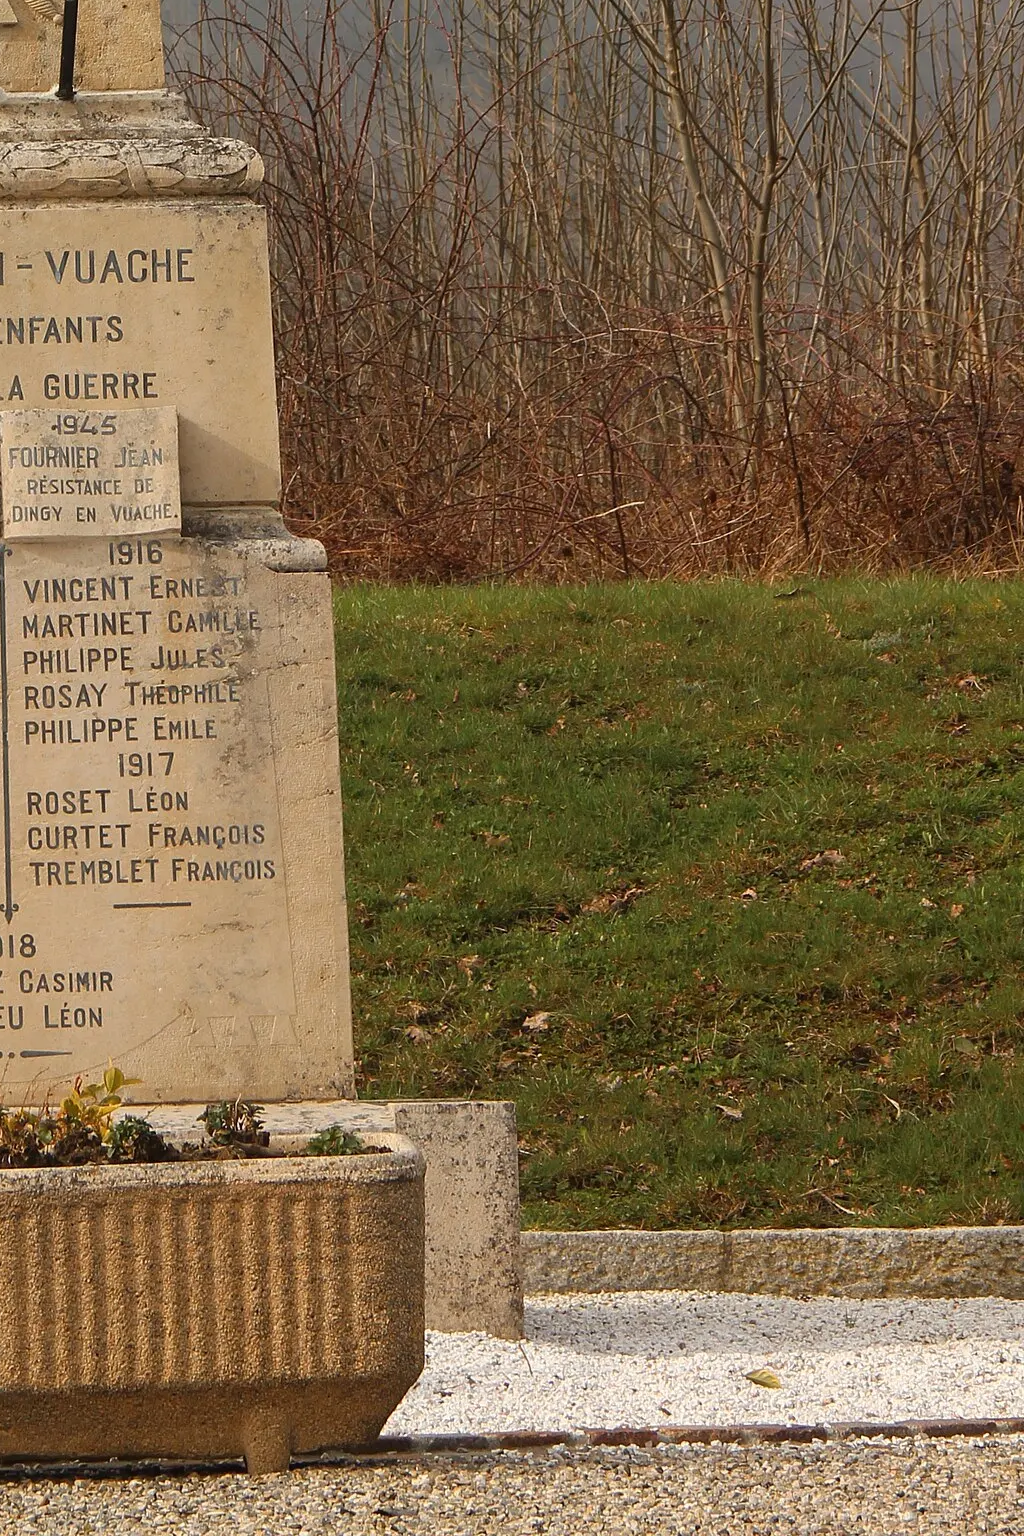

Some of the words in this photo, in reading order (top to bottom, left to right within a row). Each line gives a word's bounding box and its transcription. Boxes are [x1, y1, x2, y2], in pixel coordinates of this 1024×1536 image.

[45, 249, 195, 284] VUACHE
[44, 372, 158, 400] GUERRE
[54, 414, 117, 436] 1945
[9, 446, 99, 470] FOURNIER
[114, 447, 162, 468] JEAN
[135, 478, 154, 493] DE
[13, 505, 62, 523] DINGY
[77, 507, 96, 523] EN
[109, 540, 163, 565] 1916
[23, 577, 133, 603] VINCENT
[150, 575, 241, 599] ERNEST
[23, 611, 151, 638] MARTINET
[168, 611, 261, 634] CAMILLE
[23, 647, 134, 674] PHILIPPE
[151, 646, 225, 670] JULES
[25, 683, 108, 709] ROSAY
[125, 679, 240, 706] THÉOPHILE
[25, 718, 138, 745] PHILIPPE
[154, 717, 217, 740] EMILE
[118, 752, 174, 777] 1917
[27, 790, 111, 815] ROSET
[129, 787, 188, 813] LÉON
[28, 825, 131, 850] CURTET
[149, 823, 265, 849] FRANÇOIS
[30, 859, 159, 886] TREMBLET
[173, 859, 275, 883] FRANÇOIS
[20, 970, 113, 993] CASIMIR
[44, 1002, 102, 1028] LÉON
